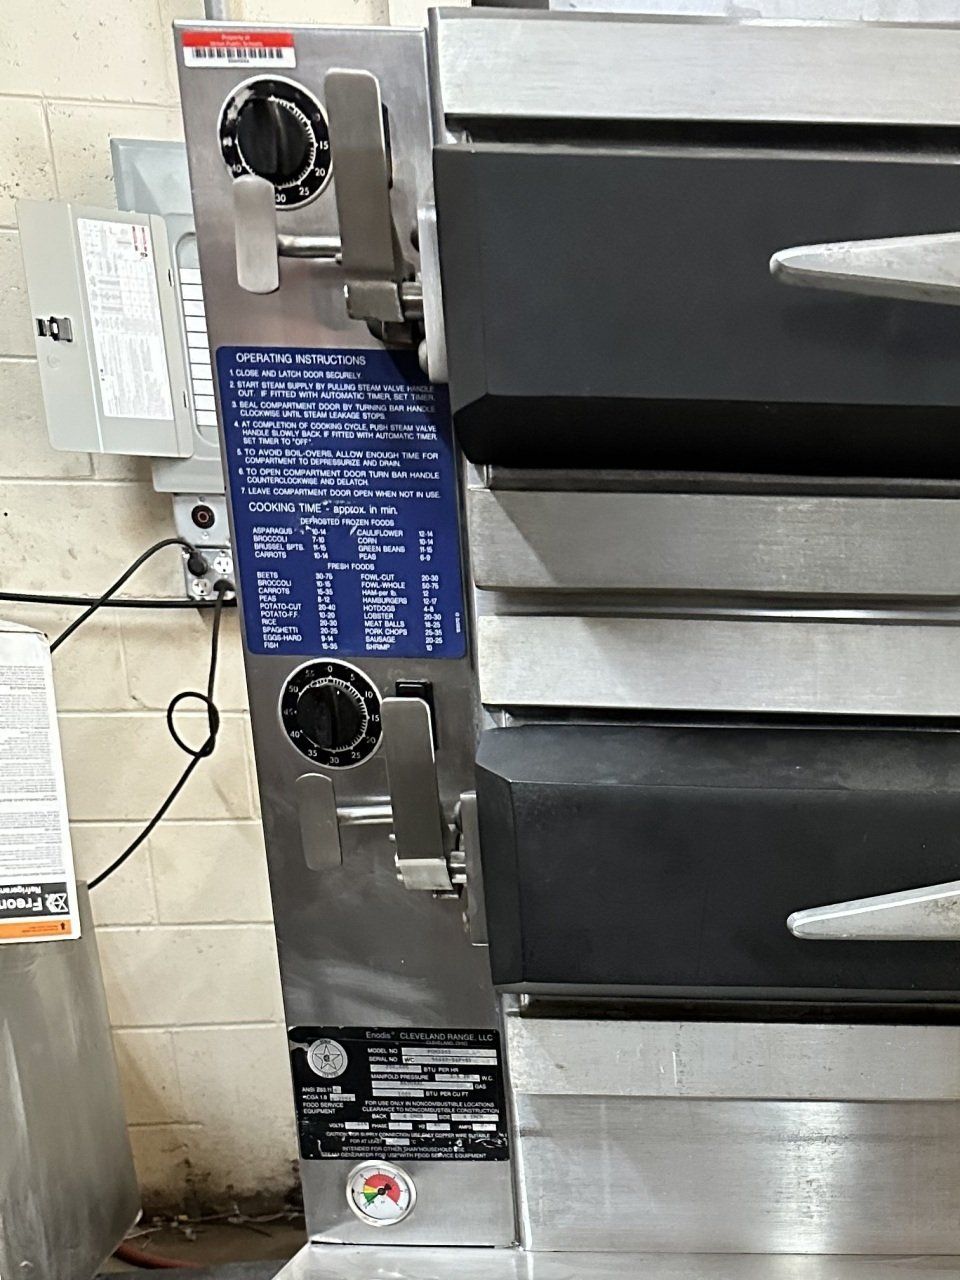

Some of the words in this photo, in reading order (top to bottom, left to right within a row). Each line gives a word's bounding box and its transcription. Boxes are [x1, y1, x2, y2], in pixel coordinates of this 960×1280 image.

[320, 141, 328, 149] 15
[315, 168, 325, 176] 20
[276, 194, 286, 202] 30
[236, 353, 292, 364] OPERATING
[295, 354, 366, 366] INSTRUCTIONS
[262, 370, 276, 378] AND
[278, 370, 301, 378] LATCH
[303, 371, 324, 379] DOOR
[261, 382, 285, 390] STEAM
[287, 382, 313, 390] SUPPLY
[315, 383, 325, 391] BY
[327, 383, 356, 391] PULLING
[358, 384, 381, 392] STEAM
[383, 384, 404, 392] VALVE
[238, 390, 256, 398] OUT.
[299, 391, 318, 399] WITH
[321, 392, 364, 400] AUTOMATIC
[260, 402, 315, 410] COMPARTMENT
[318, 403, 340, 411] DOOR
[342, 403, 352, 411] BY
[356, 404, 387, 412] TURNING
[389, 404, 404, 412] BAR
[390, 424, 413, 432] STEAM
[416, 425, 436, 433] VALVE
[366, 451, 399, 459] ENOUGH
[247, 468, 257, 476] TO
[283, 469, 340, 477] COMPARTMENT
[343, 470, 366, 478] DOOR
[391, 471, 407, 479] BAR
[410, 471, 440, 479] HANDLE
[273, 488, 327, 496] COMPARTMENT
[330, 489, 351, 497] DOOR
[375, 490, 397, 498] WHEN
[399, 490, 413, 498] NOT
[249, 503, 295, 513] COOKING
[300, 504, 321, 514] TIME
[333, 504, 366, 514] approx.
[369, 505, 377, 514] in
[380, 505, 398, 515] min.
[300, 518, 340, 526] DEFROSTED
[359, 553, 376, 561] PEAS
[363, 597, 407, 605] HAMBURGERS
